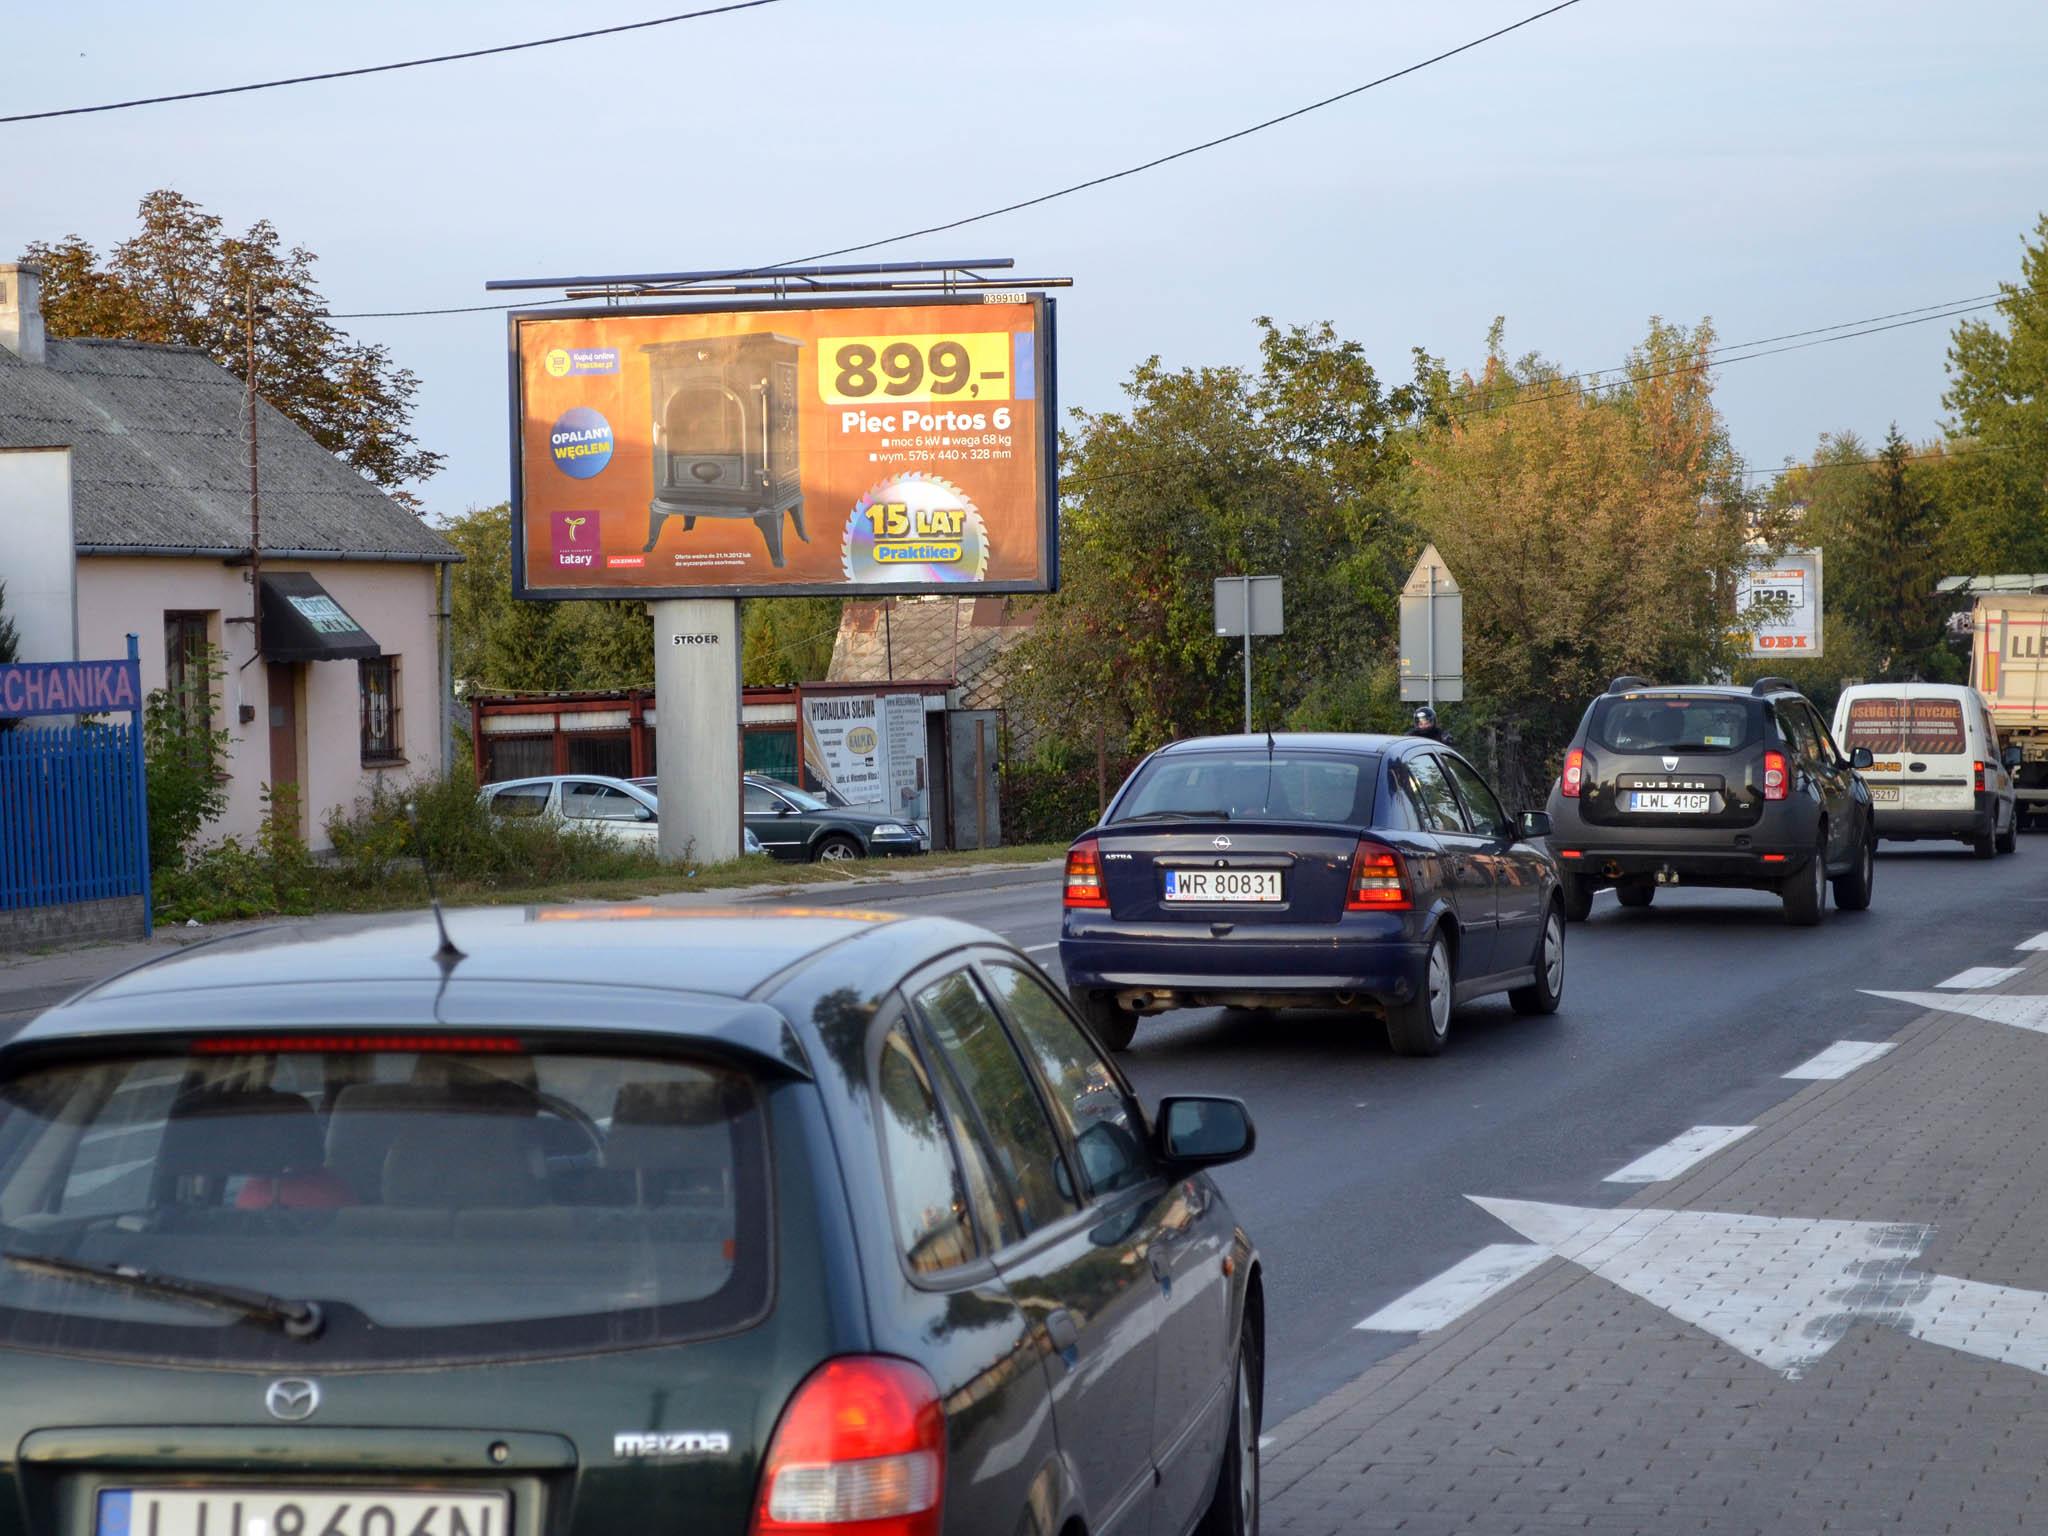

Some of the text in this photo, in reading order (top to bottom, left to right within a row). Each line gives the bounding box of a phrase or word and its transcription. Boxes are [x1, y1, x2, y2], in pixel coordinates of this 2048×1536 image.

[984, 294, 1025, 303] 0399101
[593, 352, 615, 360] online
[835, 341, 1004, 398] 899,-
[841, 407, 1012, 433] Piec Portos 6
[551, 426, 610, 445] OPALANY
[891, 435, 1012, 448] moc 6 kW waga 68 kg
[554, 442, 611, 460] WĘGLEM
[879, 452, 907, 464] wym.
[908, 451, 928, 461] 576
[938, 450, 959, 460] 440
[970, 449, 990, 460] 328
[992, 450, 1012, 459] mm
[865, 503, 967, 538] 15 LAT
[560, 554, 592, 566] tatary
[879, 545, 958, 560] Praktiker
[1760, 635, 1807, 648] OBI
[0, 666, 135, 712] CHANIKA
[811, 701, 850, 720] HYDRAULIKA
[851, 700, 876, 719] SIŁOWA
[1640, 795, 1668, 808] LWL
[1674, 795, 1708, 808] 41GP
[1179, 875, 1207, 894] WR
[1216, 874, 1276, 894] 80831
[614, 1432, 731, 1457] mazda
